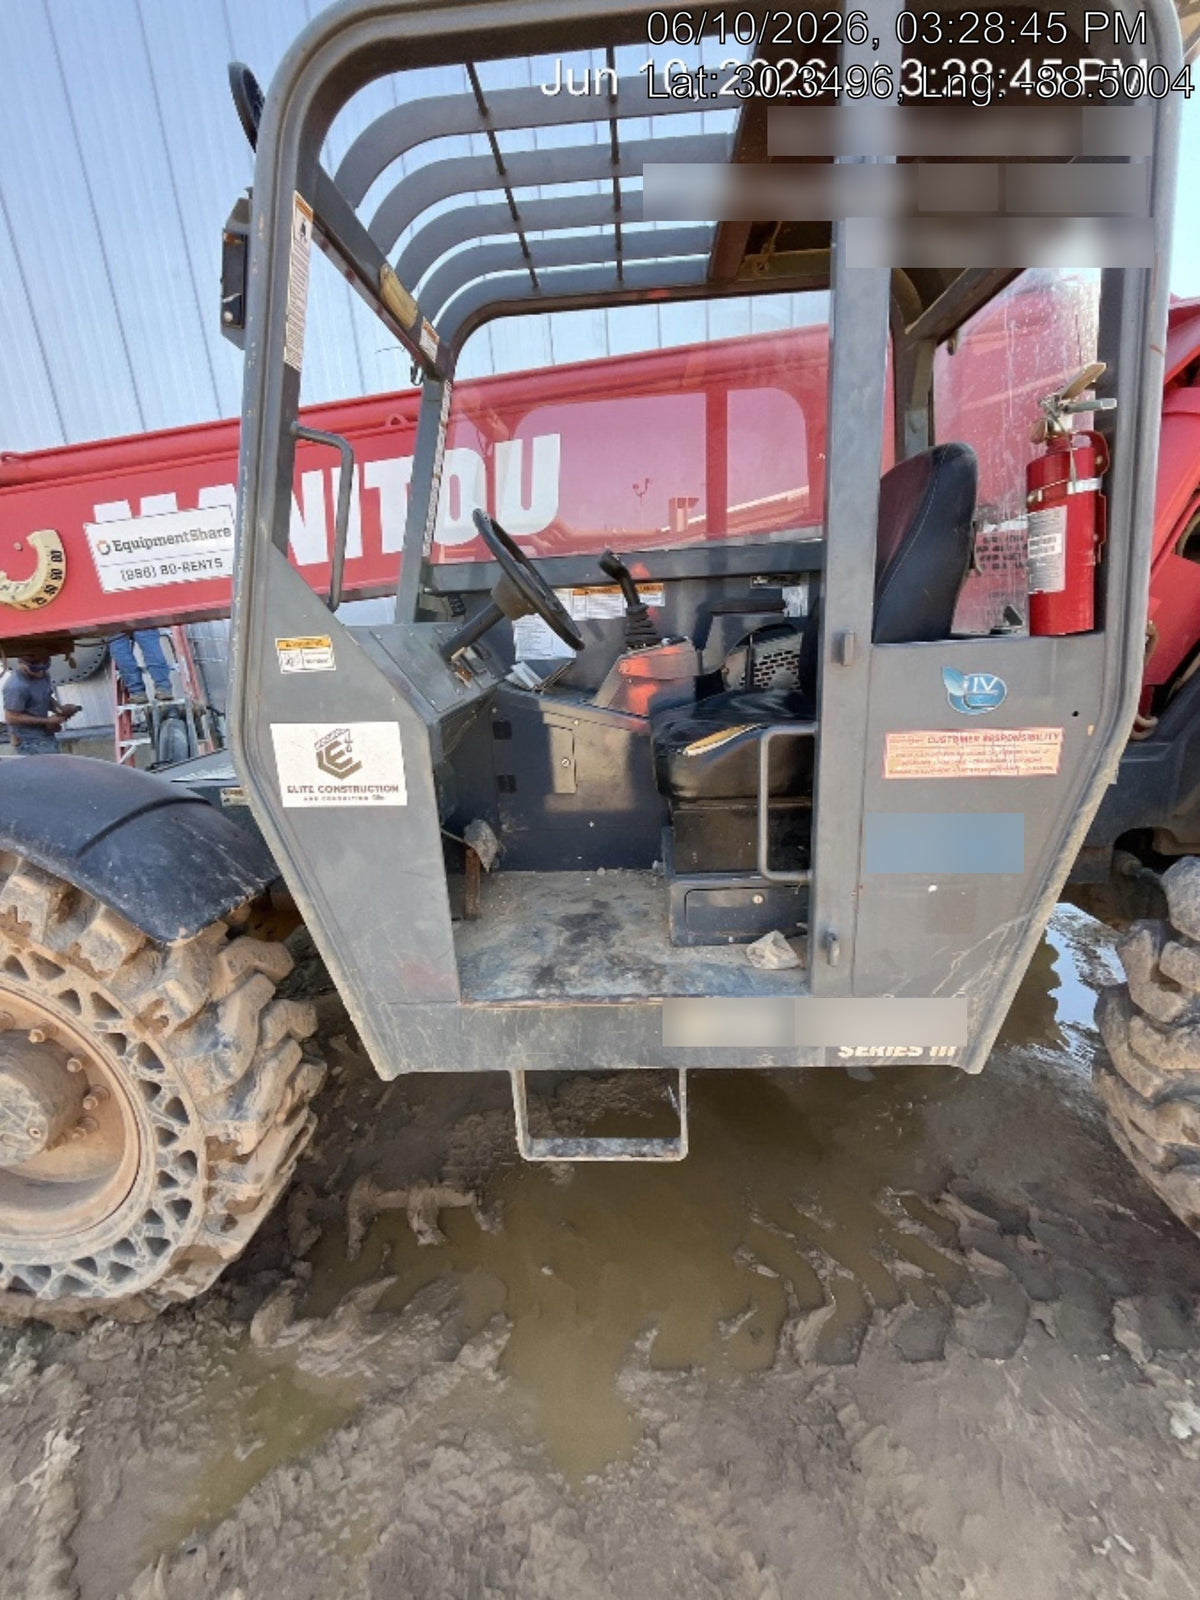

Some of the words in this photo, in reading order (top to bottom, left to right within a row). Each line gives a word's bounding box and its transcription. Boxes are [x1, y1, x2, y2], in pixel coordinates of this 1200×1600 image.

[93, 433, 561, 567] NITOU
[111, 526, 232, 552] EquipmentShare
[160, 557, 224, 576] 80-RENTS
[287, 785, 315, 794] ELITE
[317, 785, 399, 794] CONSTRUCTION
